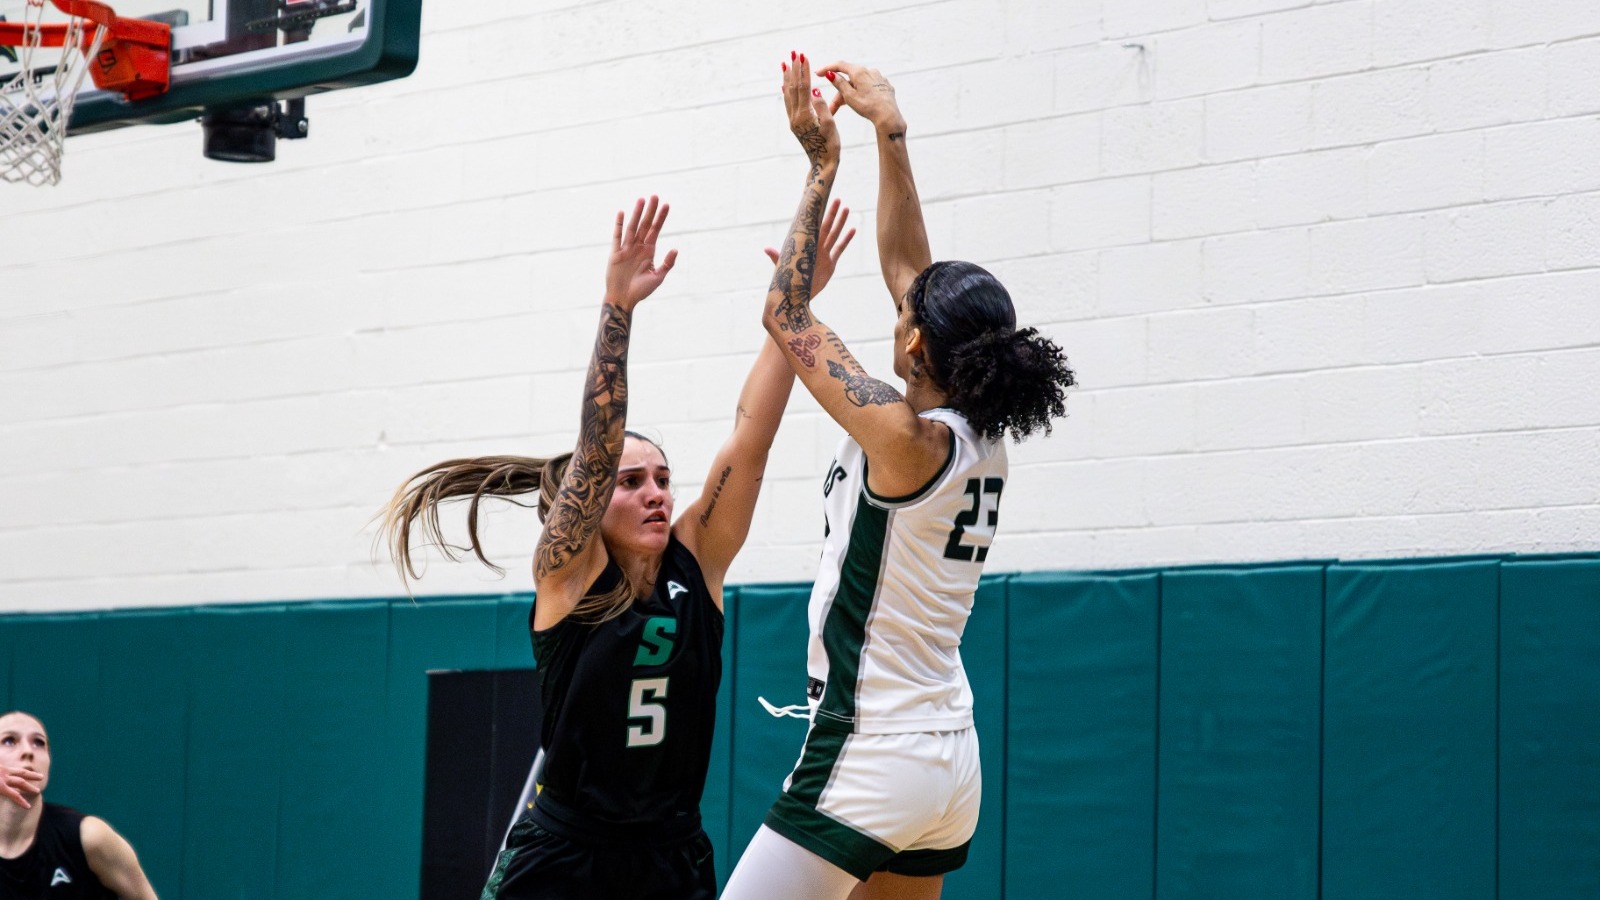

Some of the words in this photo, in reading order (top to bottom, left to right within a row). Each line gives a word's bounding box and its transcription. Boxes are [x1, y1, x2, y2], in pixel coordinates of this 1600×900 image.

[943, 477, 1004, 563] 23
[632, 616, 677, 667] S
[626, 676, 669, 748] 5
